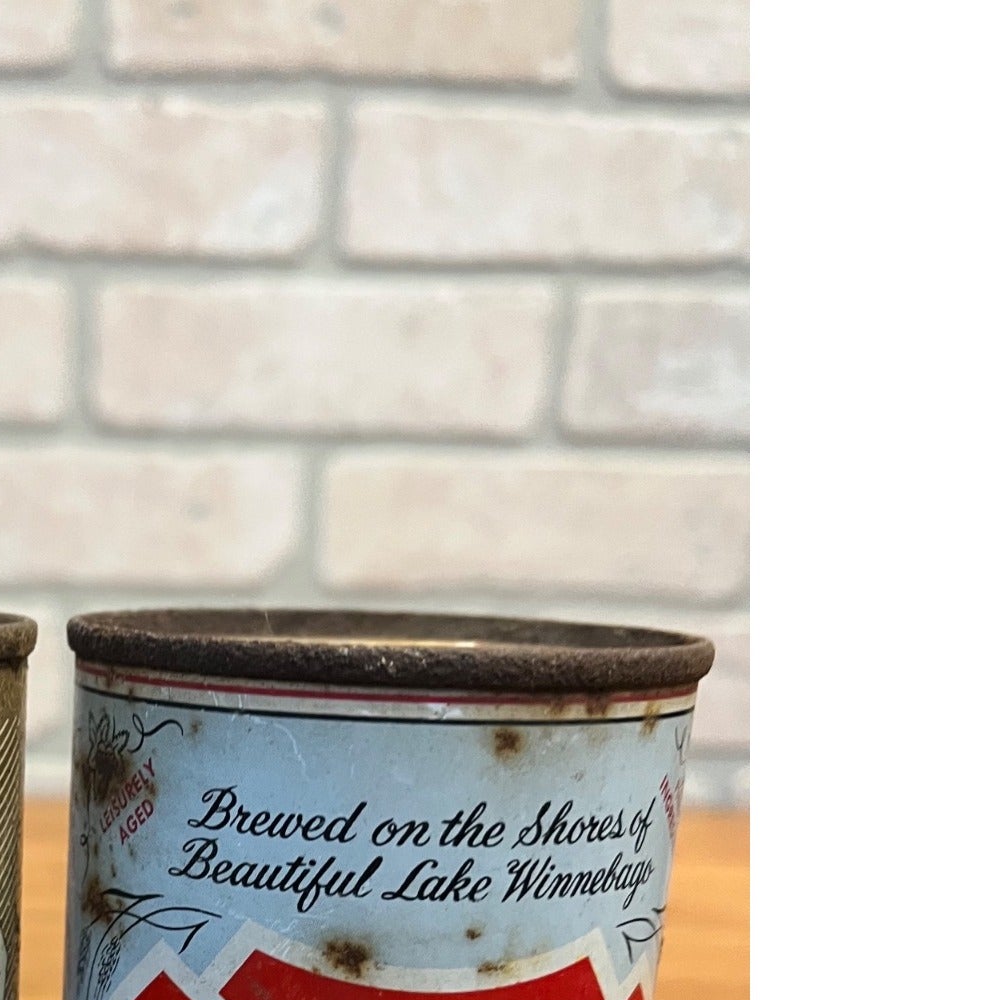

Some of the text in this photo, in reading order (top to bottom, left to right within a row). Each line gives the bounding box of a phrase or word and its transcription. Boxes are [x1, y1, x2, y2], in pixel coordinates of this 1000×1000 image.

[99, 757, 156, 833] LEISURELY
[118, 797, 155, 845] AGED
[187, 784, 368, 843] Brewed
[371, 816, 430, 847] on
[438, 801, 506, 849] the
[511, 800, 625, 849] Shores
[629, 796, 657, 853] of
[168, 837, 656, 912] Beautiful Lake Winnebago
